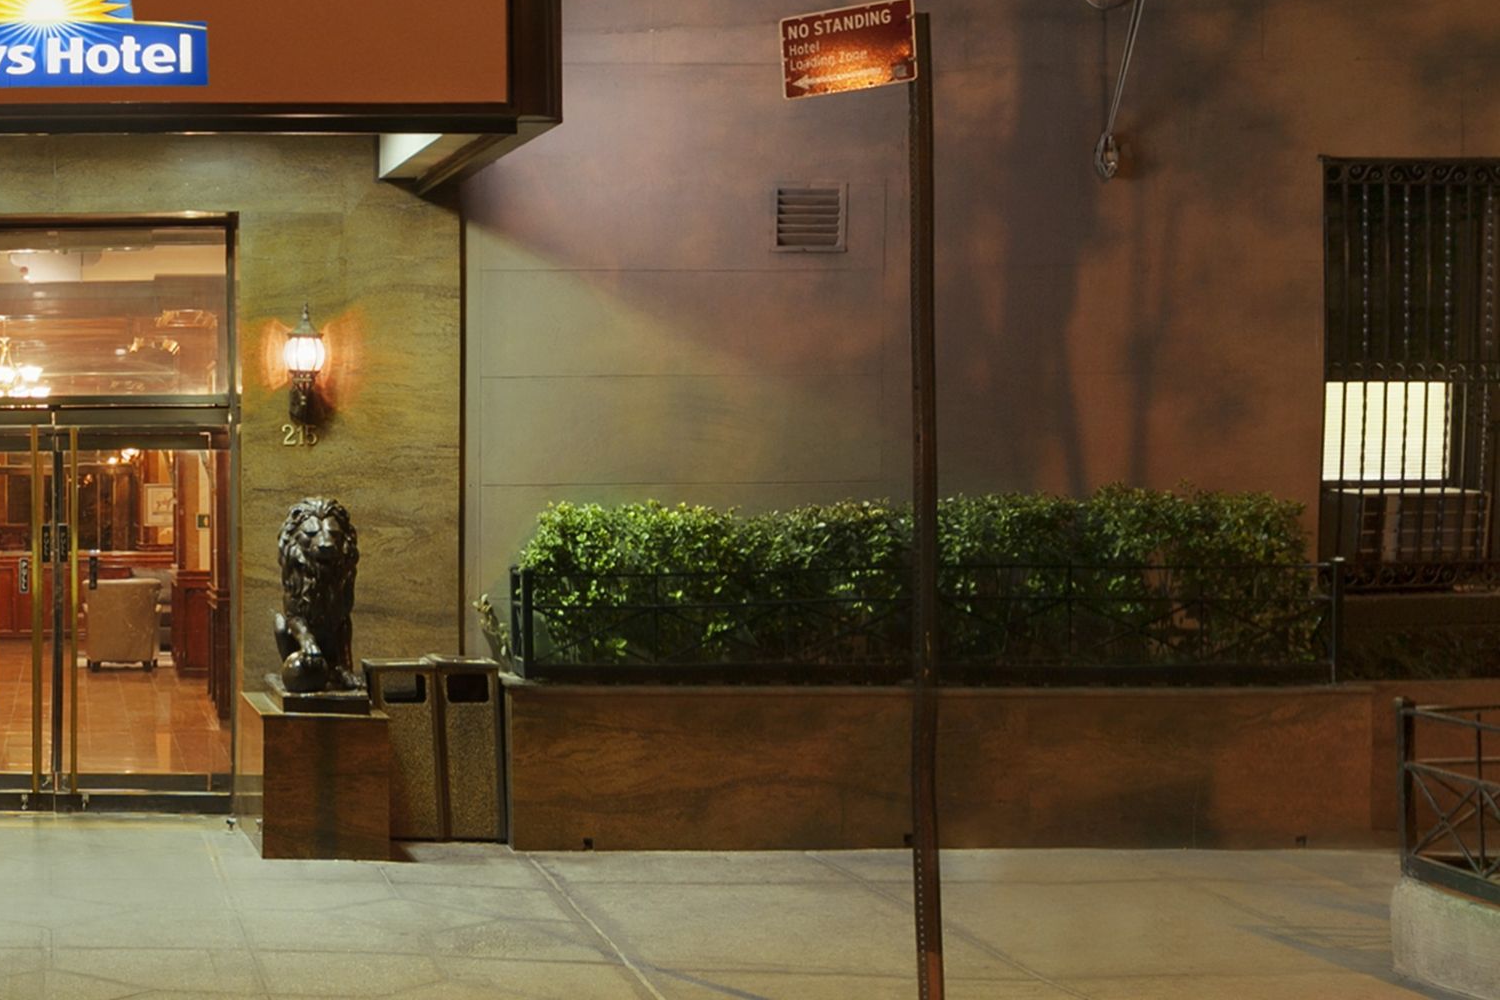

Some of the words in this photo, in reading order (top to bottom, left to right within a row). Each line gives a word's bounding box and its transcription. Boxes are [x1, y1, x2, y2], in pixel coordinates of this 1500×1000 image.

[787, 23, 809, 40] NO
[814, 9, 892, 36] STANDING
[47, 33, 193, 75] Hotel
[789, 40, 820, 56] Hotel
[790, 54, 835, 71] Loading
[838, 49, 868, 64] Zone
[282, 424, 318, 447] 215
